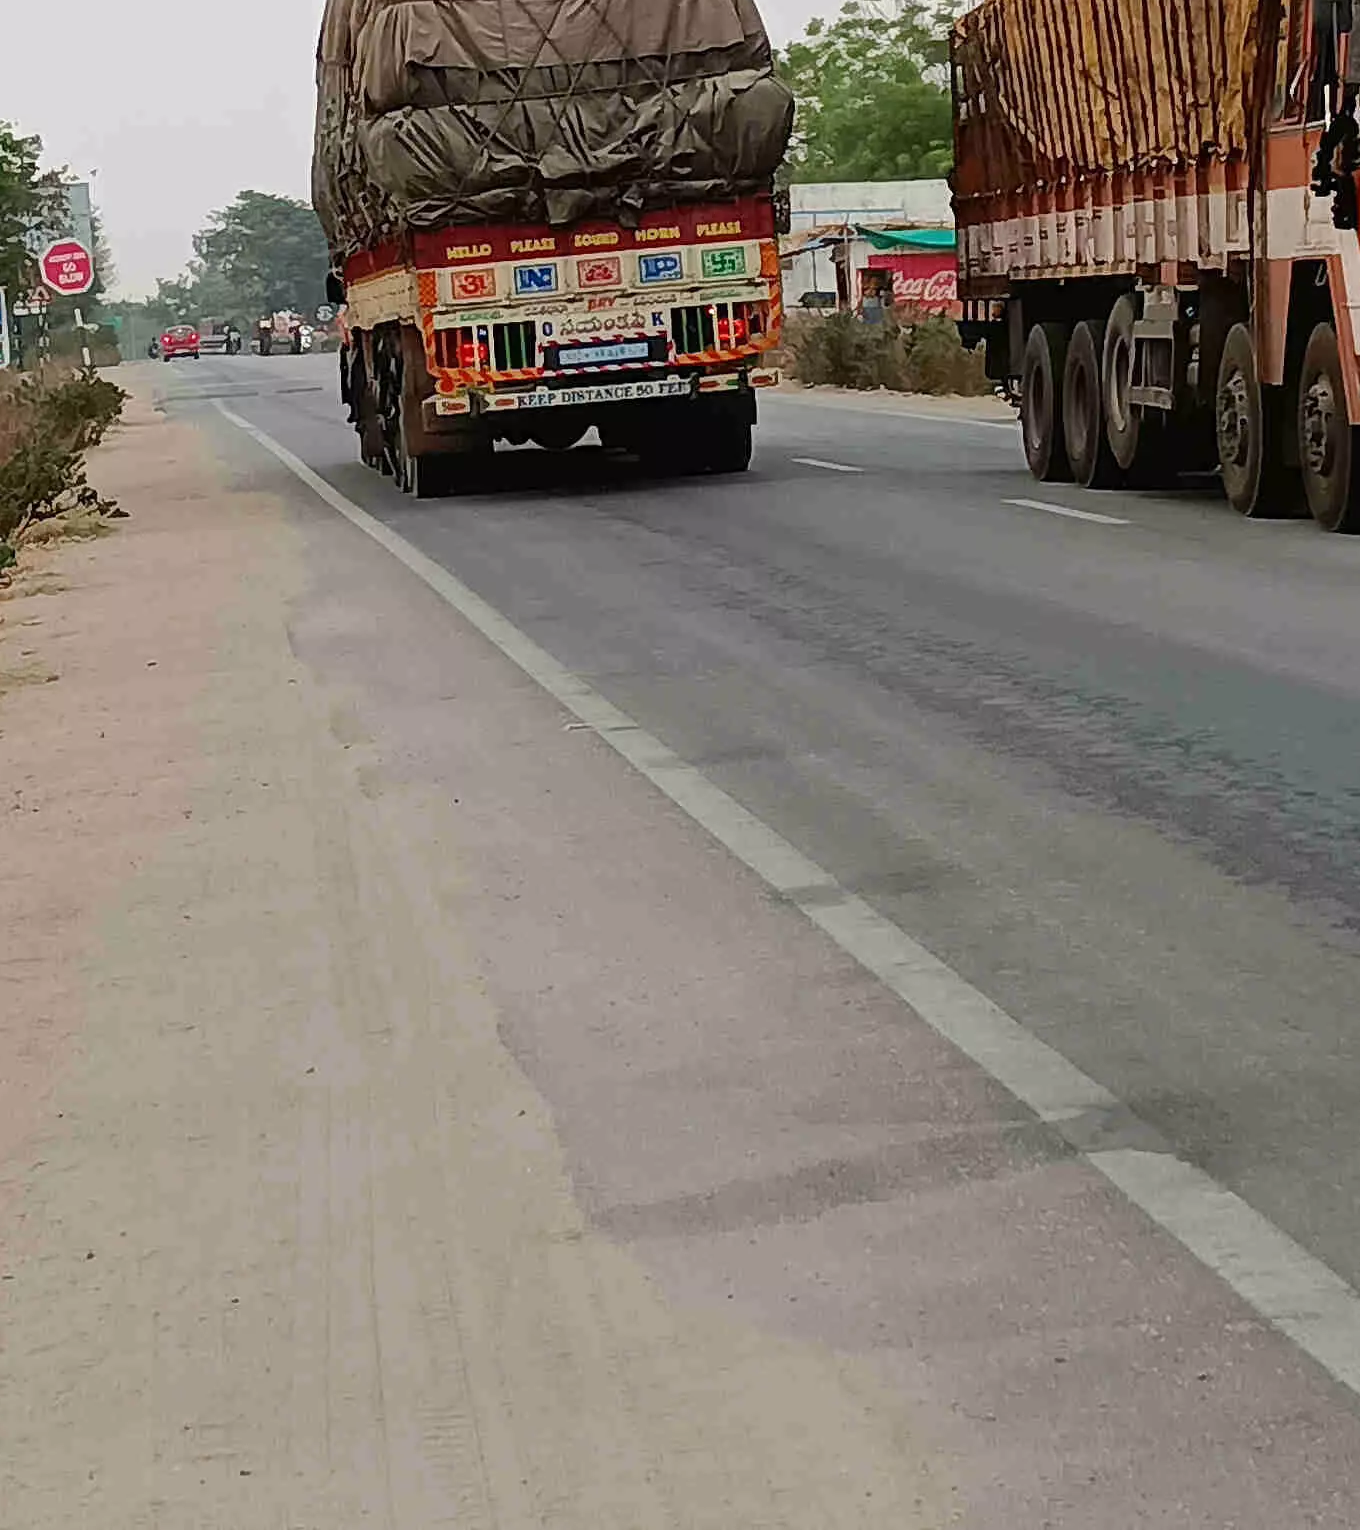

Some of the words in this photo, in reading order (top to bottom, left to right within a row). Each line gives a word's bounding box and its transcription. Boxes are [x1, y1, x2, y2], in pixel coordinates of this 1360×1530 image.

[510, 237, 556, 254] PLEASE
[634, 225, 681, 242] HORN
[696, 221, 742, 237] PLEASE
[651, 311, 664, 326] K
[517, 395, 556, 408] KEEP
[562, 385, 633, 402] DISTANCE
[636, 383, 654, 397] 50
